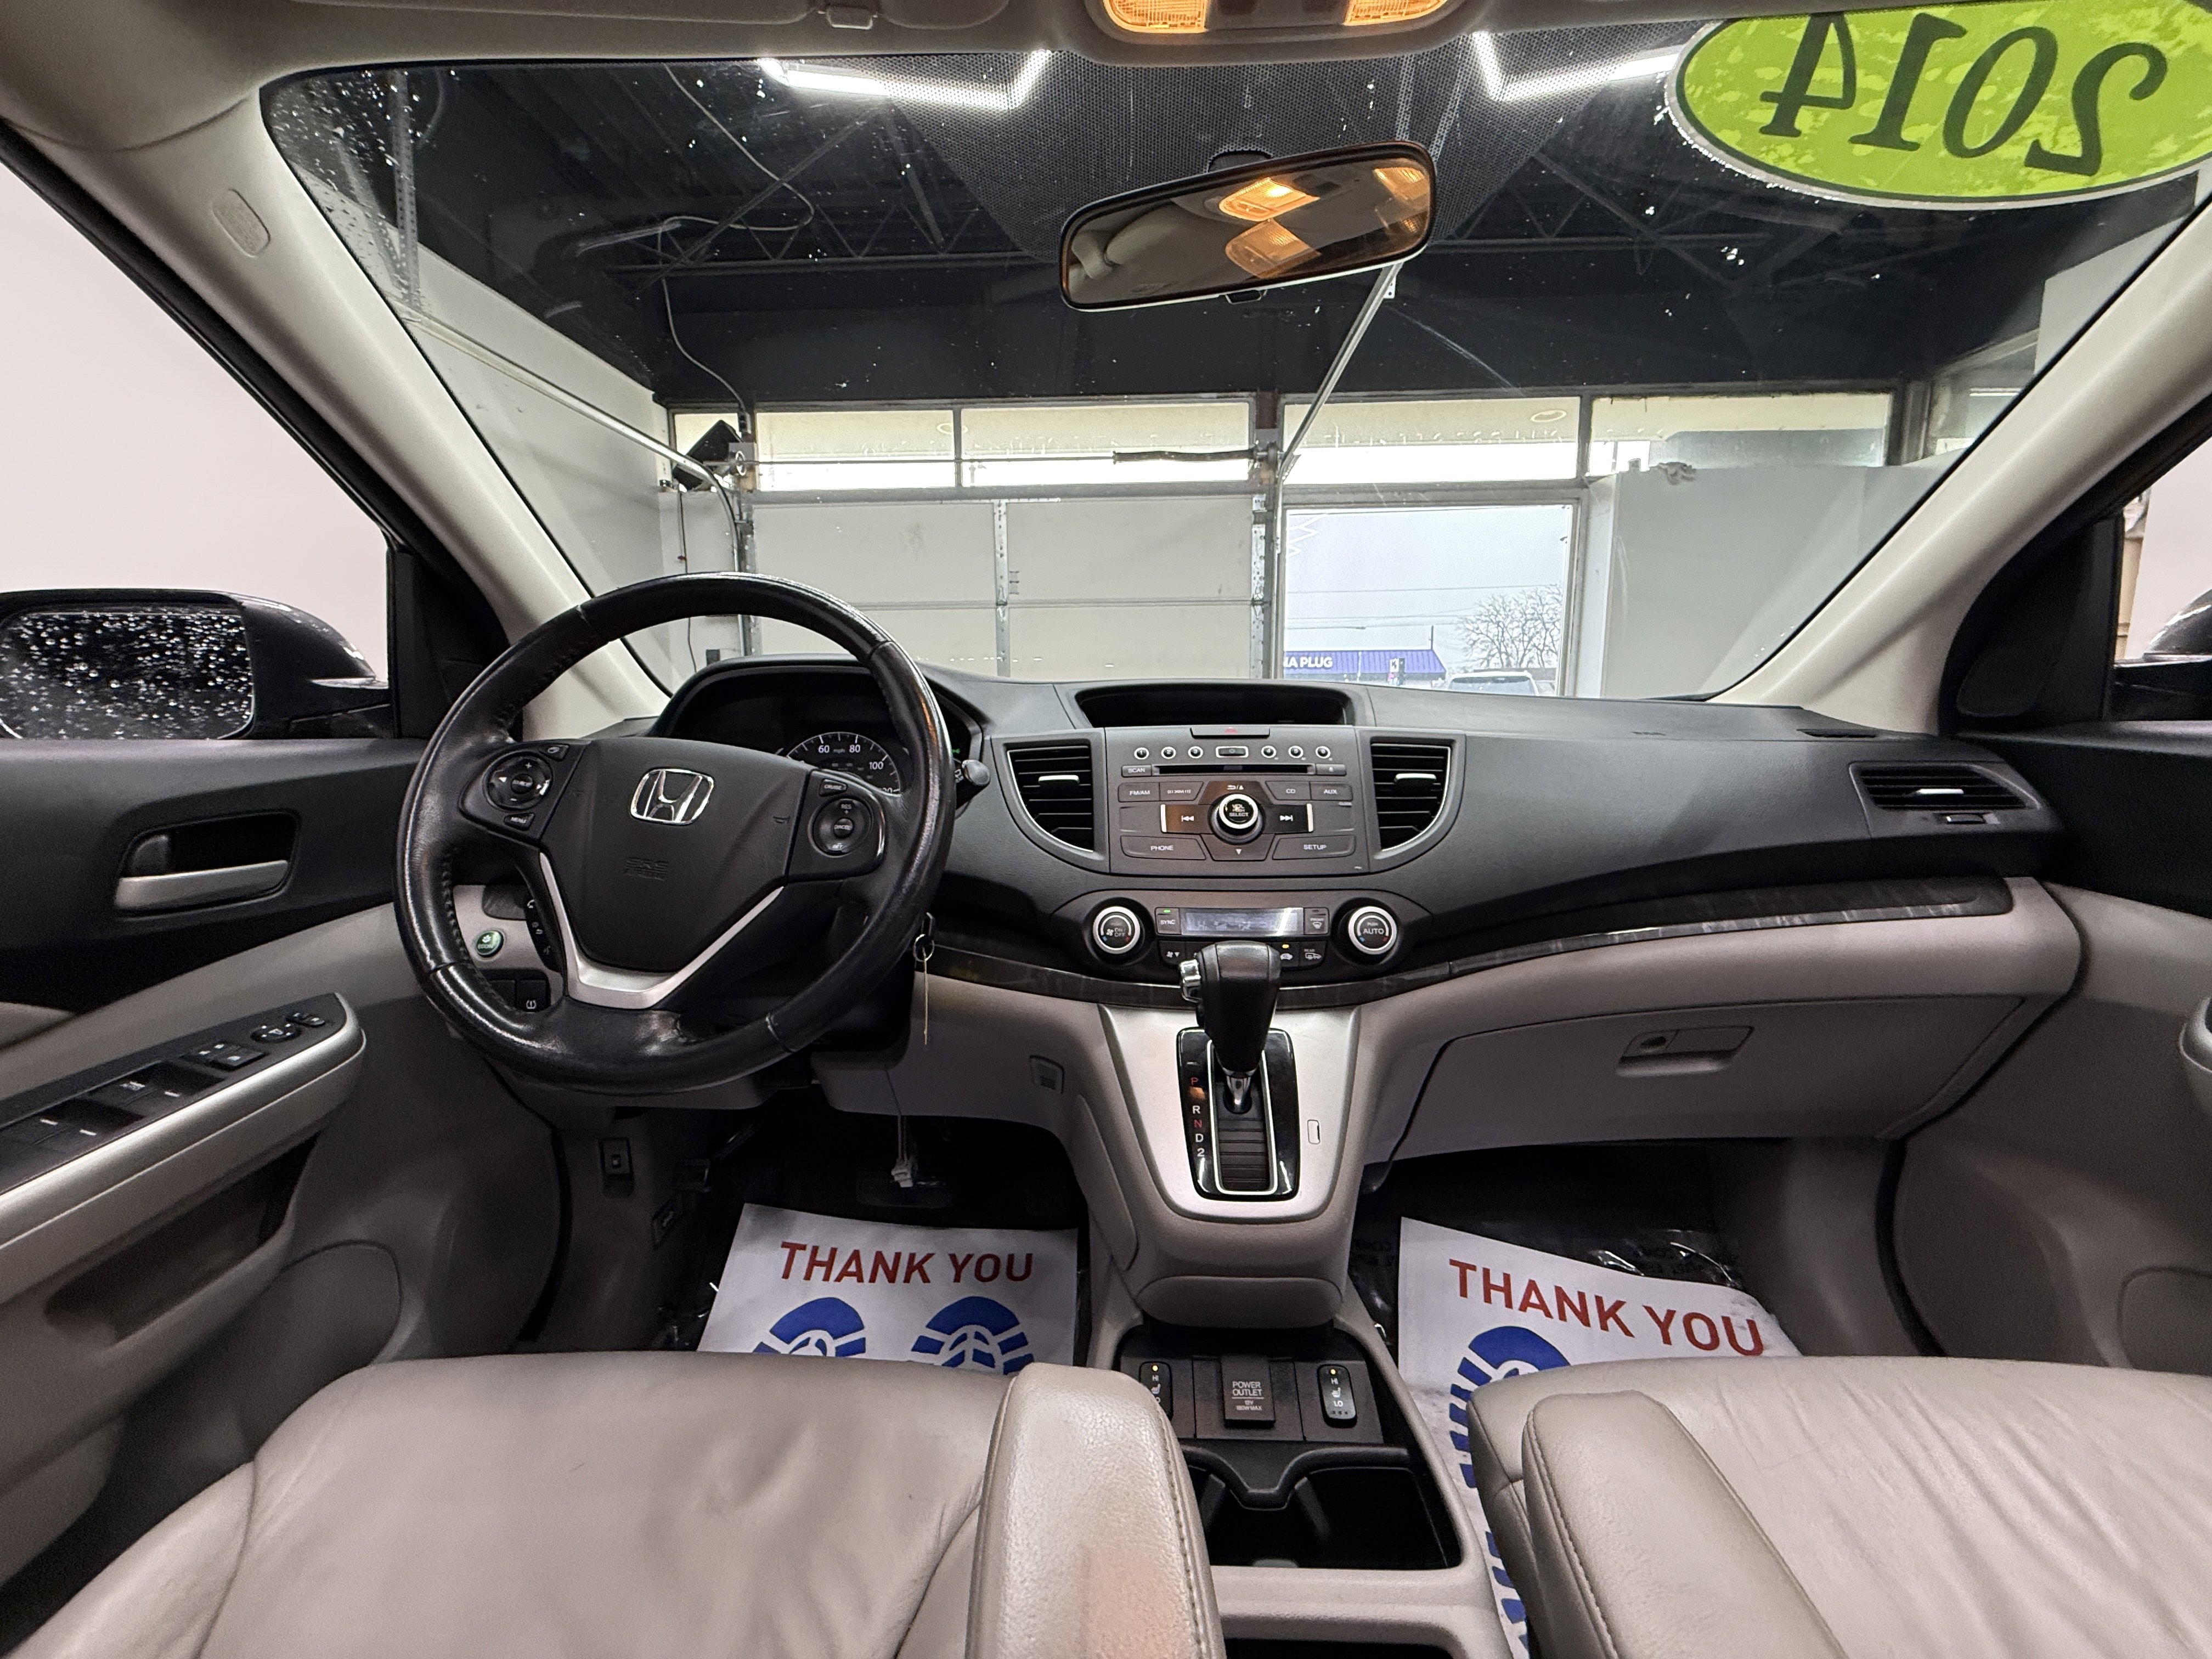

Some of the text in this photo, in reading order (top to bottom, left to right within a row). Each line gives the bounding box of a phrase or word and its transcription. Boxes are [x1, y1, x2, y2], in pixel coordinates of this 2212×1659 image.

[1300, 656, 1333, 668] PLUG
[818, 745, 830, 753] 60
[849, 744, 861, 753] 80
[869, 761, 884, 770] 100
[1193, 1105, 1200, 1114] R
[1194, 1119, 1203, 1127] N
[1195, 1133, 1204, 1142] D
[1197, 1148, 1205, 1157] 2
[781, 1241, 1033, 1284] THANK YOU
[1449, 1259, 1764, 1357] THANK YOU
